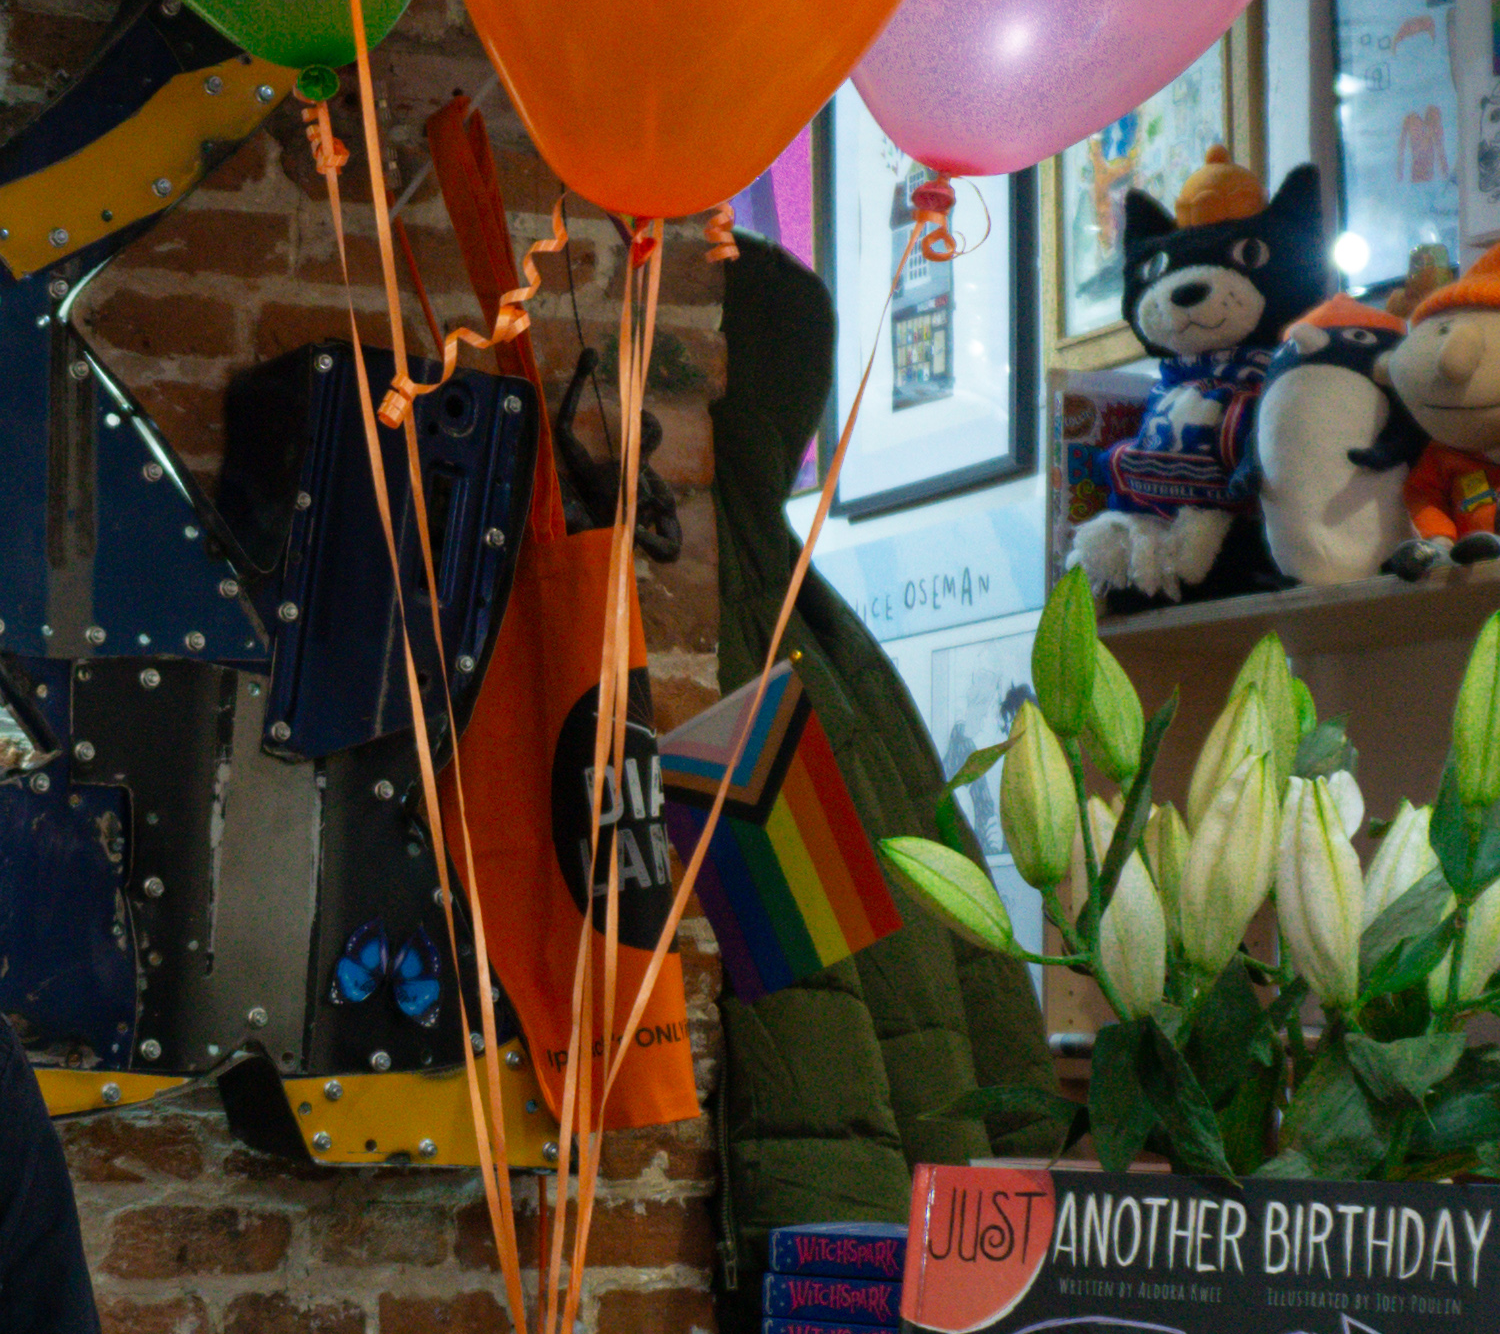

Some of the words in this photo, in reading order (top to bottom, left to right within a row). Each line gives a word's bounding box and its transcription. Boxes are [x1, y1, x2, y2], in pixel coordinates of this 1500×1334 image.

[903, 569, 993, 606] OSEMAN
[928, 1188, 1046, 1264] JUST
[1053, 1192, 1245, 1275] ANOTHER
[1263, 1201, 1491, 1289] BIRTHDAY
